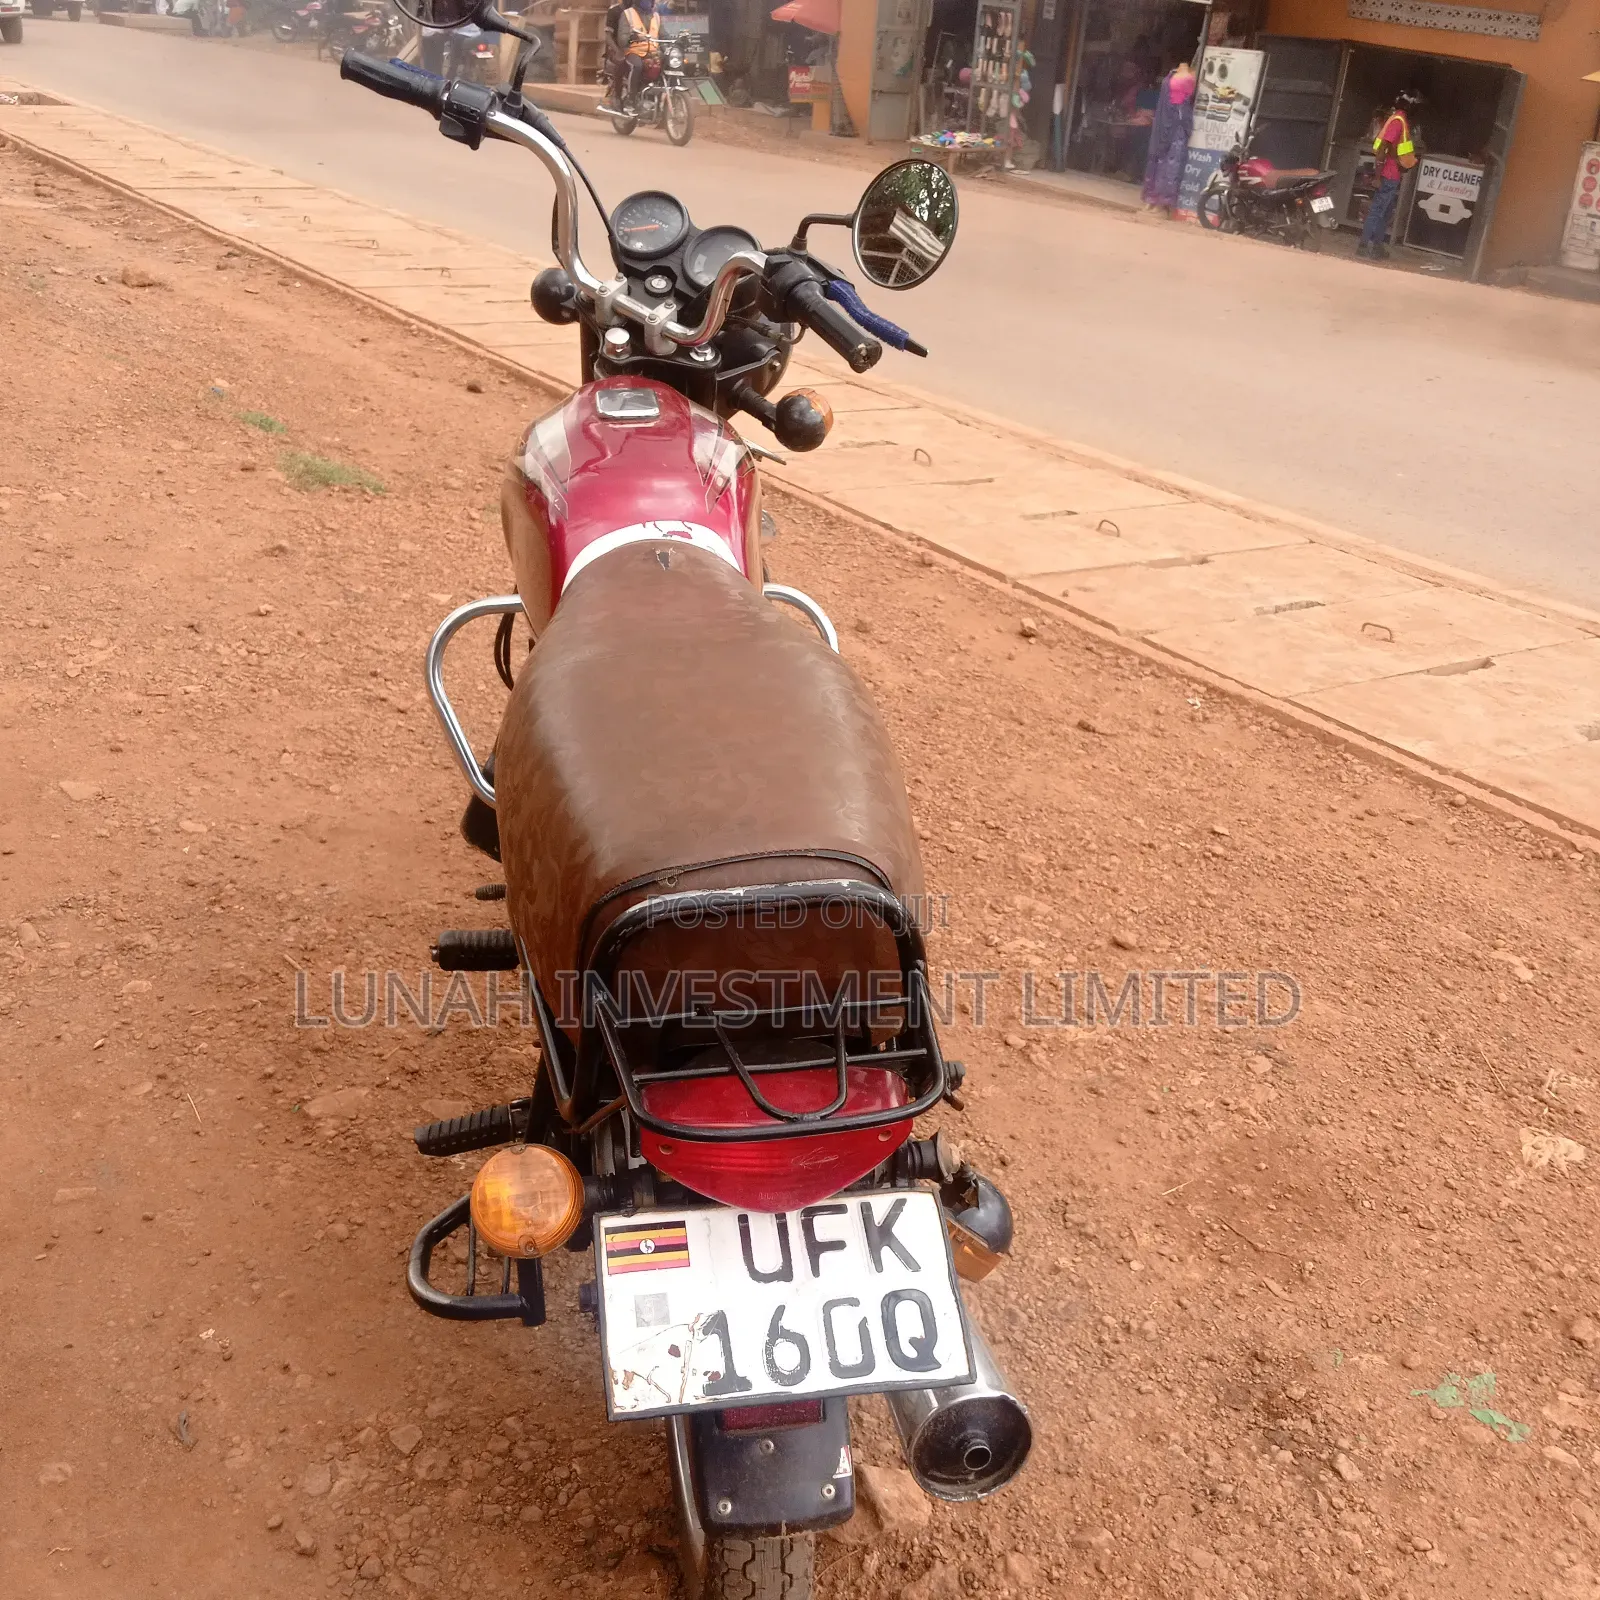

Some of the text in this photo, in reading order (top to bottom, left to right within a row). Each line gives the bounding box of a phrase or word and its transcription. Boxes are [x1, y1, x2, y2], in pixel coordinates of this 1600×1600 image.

[1205, 133, 1236, 150] SHO
[1188, 150, 1212, 162] Wash
[1185, 164, 1202, 177] Dry
[1422, 165, 1483, 187] DRY CLEANER
[1437, 182, 1475, 198] Laundry
[737, 1197, 922, 1284] UFK
[702, 1288, 942, 1396] 160Q
